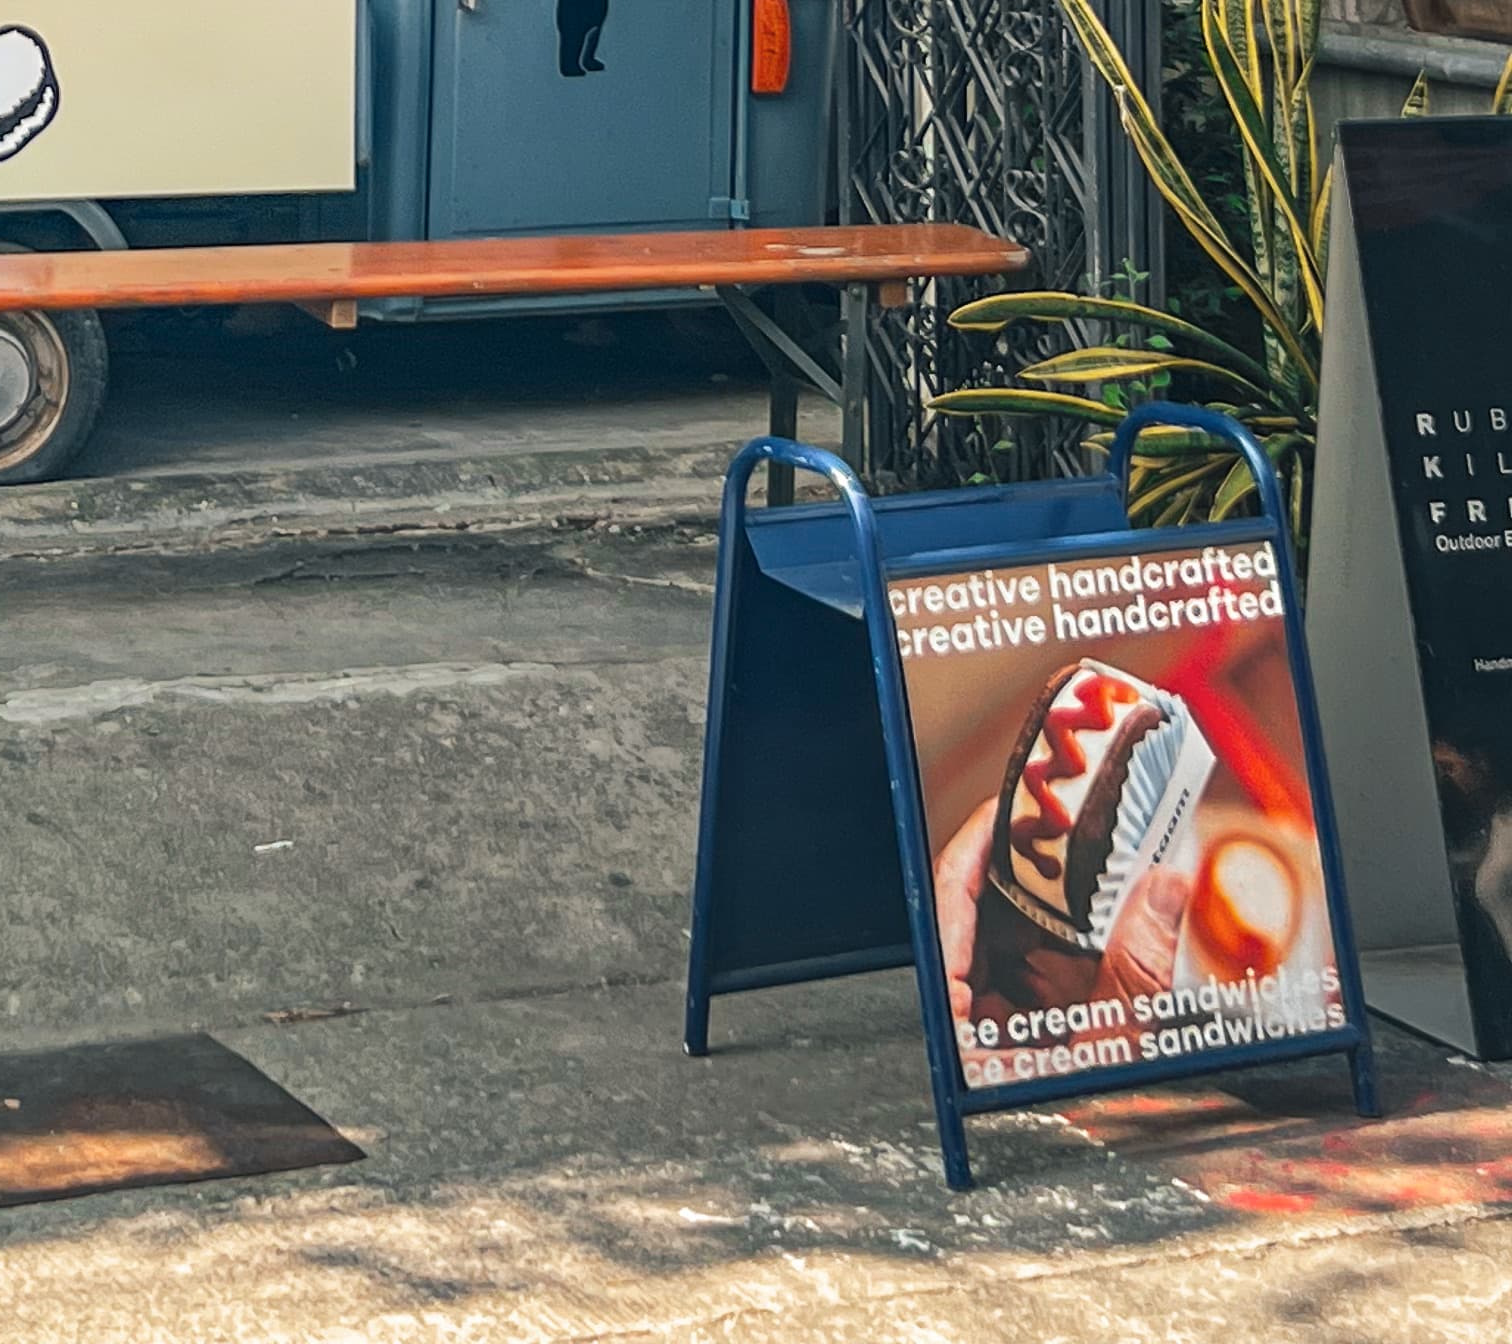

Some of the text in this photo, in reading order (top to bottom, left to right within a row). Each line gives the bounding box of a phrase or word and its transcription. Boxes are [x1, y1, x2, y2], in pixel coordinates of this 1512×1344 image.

[1429, 498, 1512, 524] FR
[1436, 533, 1500, 552] Outdoor
[889, 541, 1276, 616] creative handcrafted
[897, 580, 1285, 657] creative handcrafted
[1007, 1002, 1126, 1042] cream
[1013, 1035, 1132, 1080] cream
